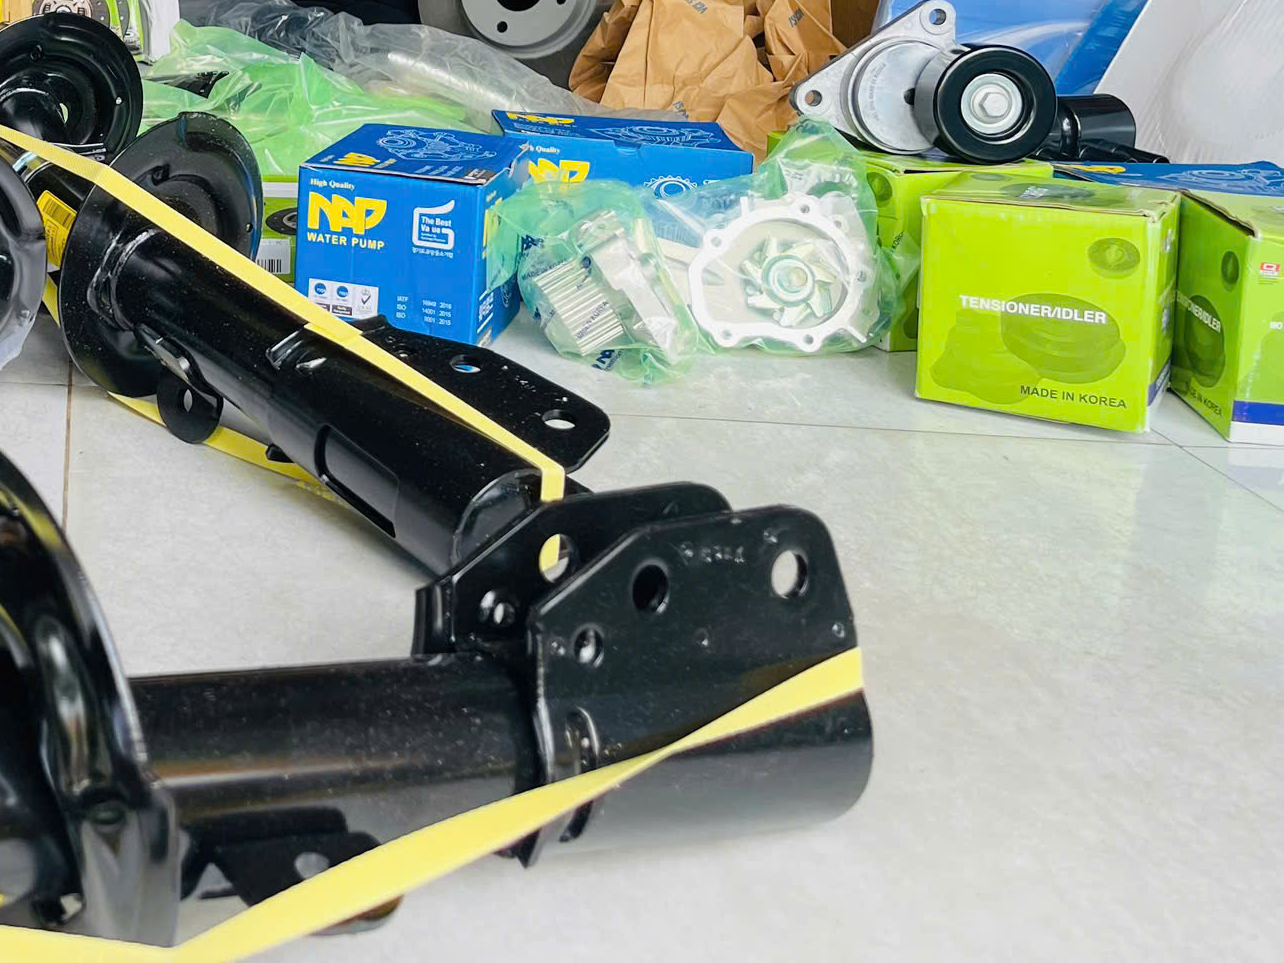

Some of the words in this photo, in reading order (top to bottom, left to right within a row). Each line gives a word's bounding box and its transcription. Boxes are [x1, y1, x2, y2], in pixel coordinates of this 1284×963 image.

[310, 178, 329, 188] High
[330, 180, 355, 191] Quality
[420, 216, 435, 225] The
[435, 218, 452, 227] Best
[307, 232, 348, 246] WATER
[351, 237, 385, 250] PUMP
[438, 310, 452, 318] 2015
[959, 294, 1109, 325] TENSIONER/IDLER
[438, 318, 452, 326] 2015
[1020, 384, 1058, 399] MADE
[1061, 390, 1075, 403] IN
[1078, 393, 1127, 410] KOREA
[1203, 397, 1222, 417] KOREA
